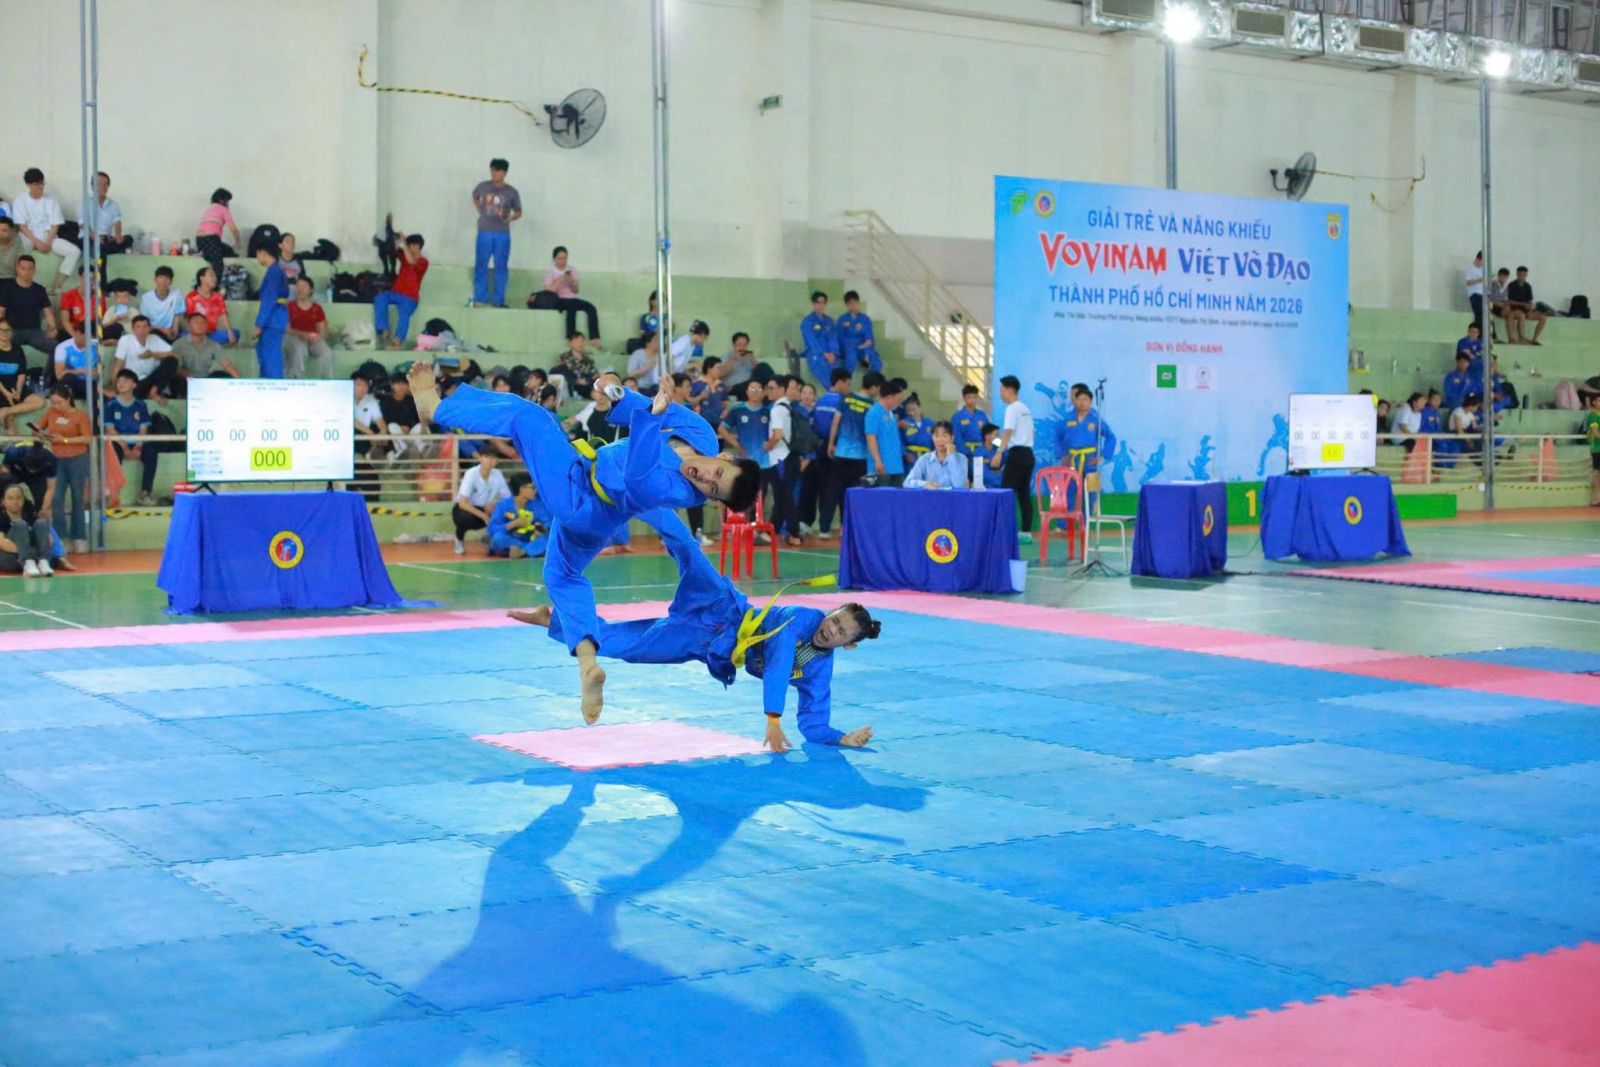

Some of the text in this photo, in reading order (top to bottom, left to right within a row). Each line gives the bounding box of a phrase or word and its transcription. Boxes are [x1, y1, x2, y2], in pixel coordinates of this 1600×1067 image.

[1088, 206, 1271, 240] GIẢI TRẺ VÀ NĂNG KHIẾU
[1049, 283, 1104, 305] THÀNH
[1108, 284, 1140, 306] PHỐ
[1168, 289, 1193, 310] CHÍ
[1196, 293, 1232, 311] MINH
[1235, 293, 1267, 313] NĂM
[1270, 297, 1303, 314] 2026
[197, 428, 214, 442] 00
[229, 428, 246, 442] 00
[261, 428, 278, 442] 00
[292, 428, 309, 442] 00
[323, 428, 340, 442] 00
[254, 450, 286, 468] 000
[1245, 488, 1257, 518] 1
